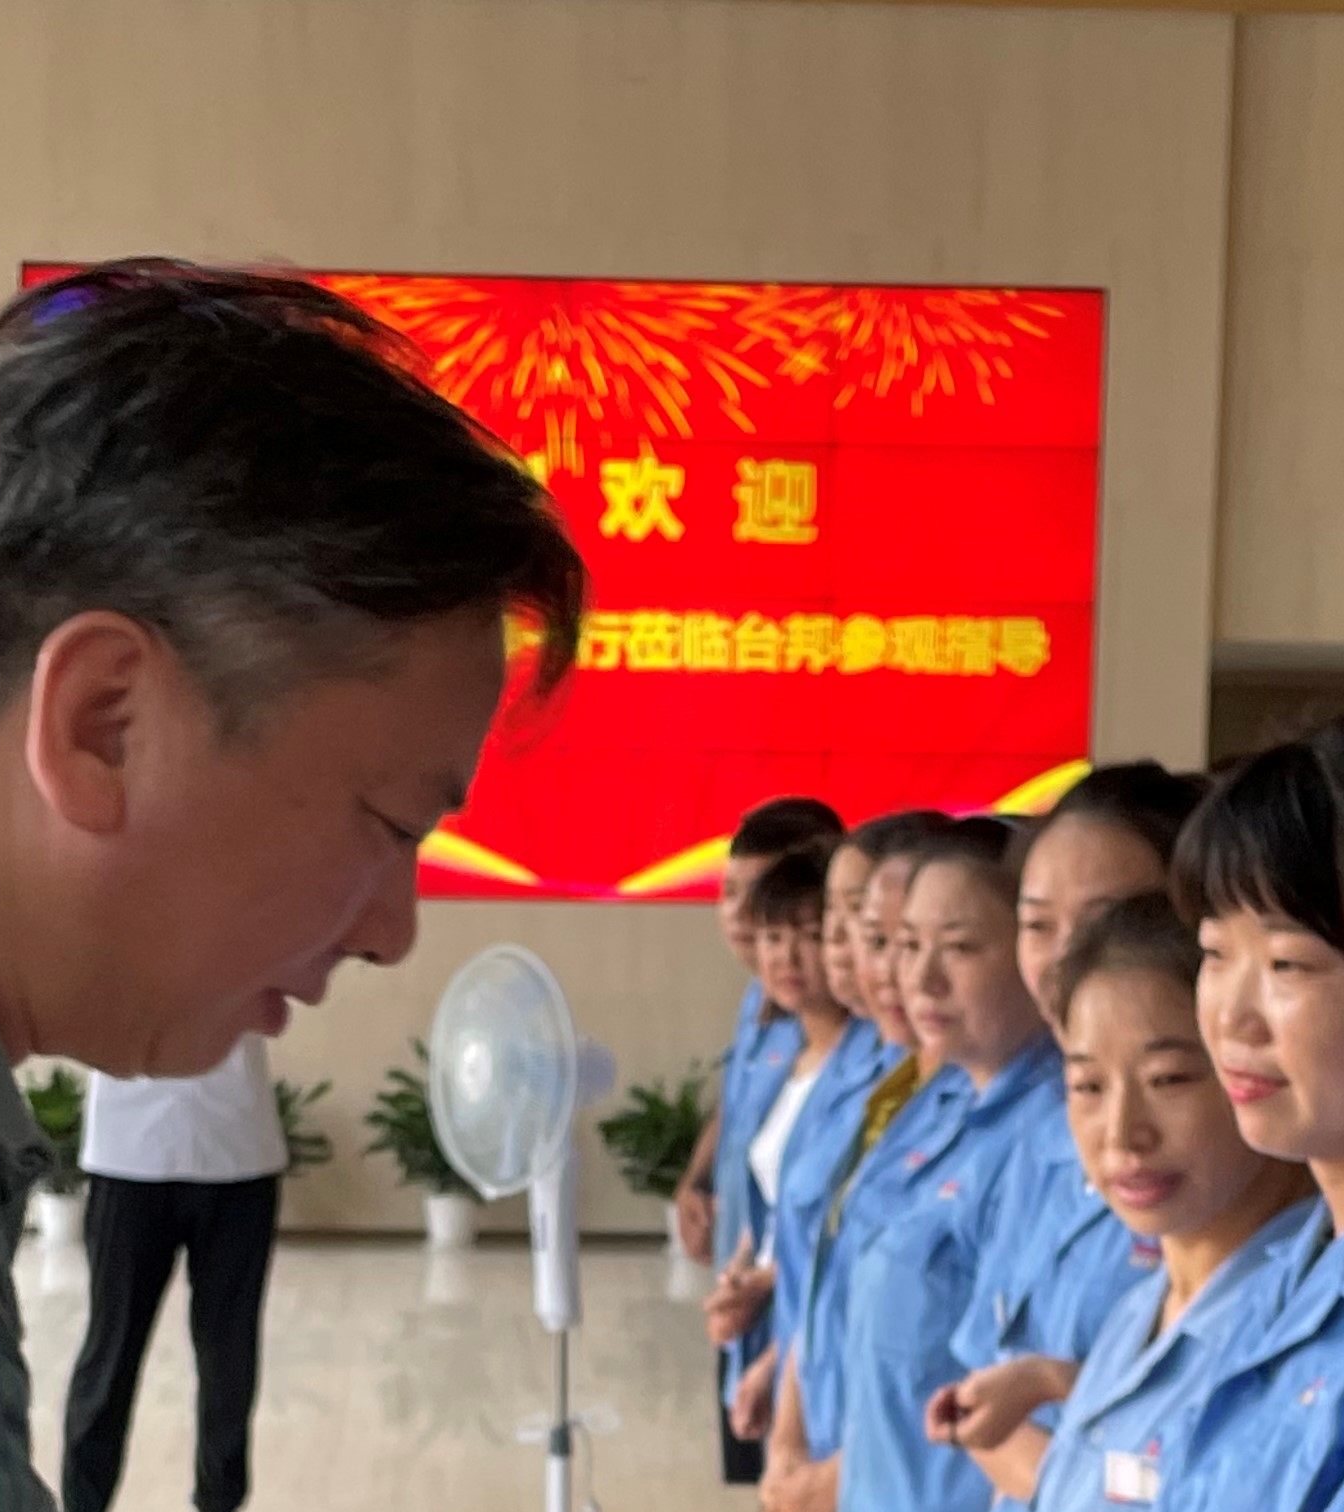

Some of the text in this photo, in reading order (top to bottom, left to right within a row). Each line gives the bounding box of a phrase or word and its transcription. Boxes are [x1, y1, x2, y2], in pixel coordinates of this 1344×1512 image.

[598, 457, 819, 544] 欢迎
[504, 610, 1050, 676] 行莅临台邦参观指导
